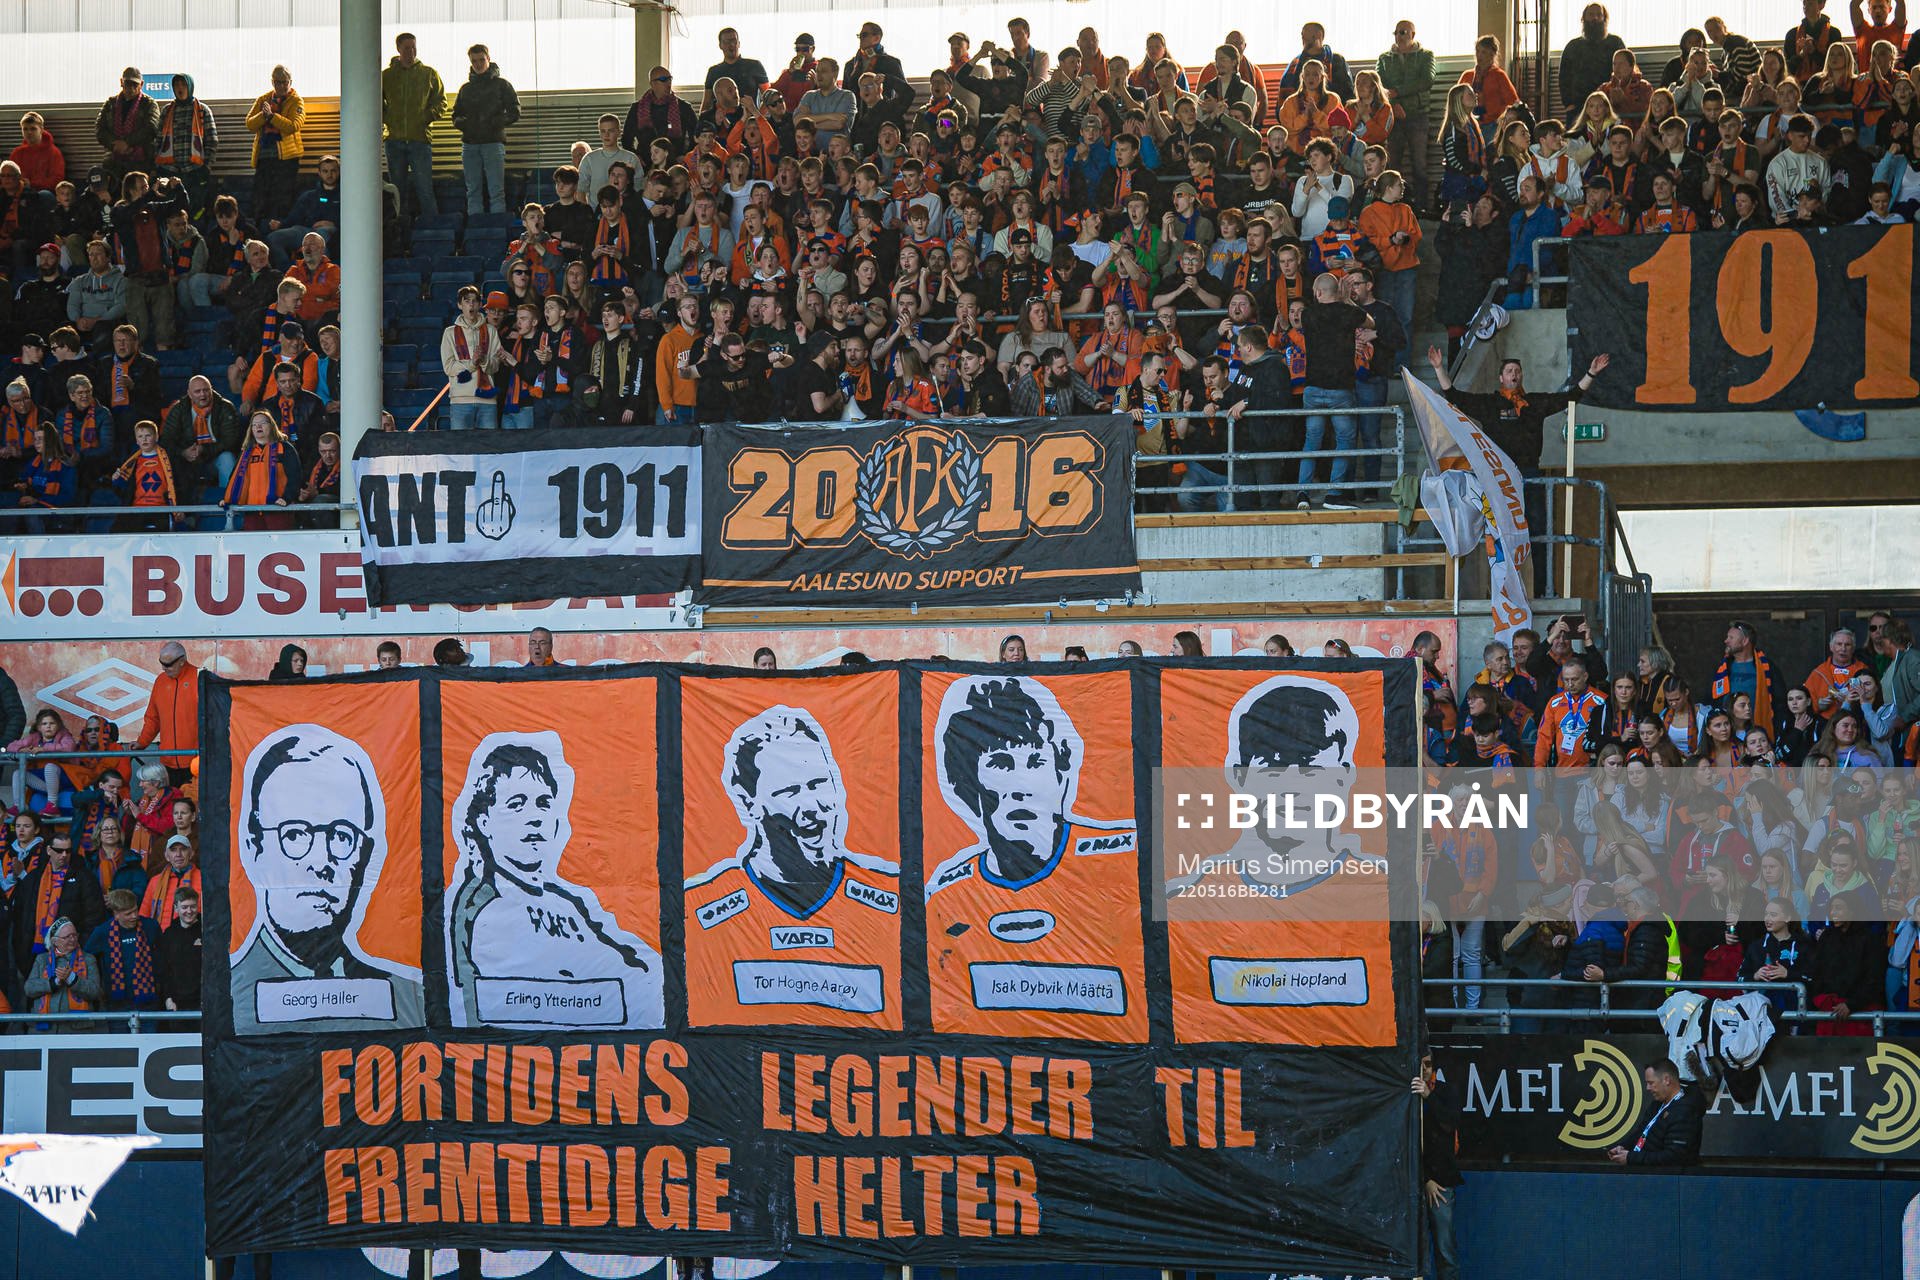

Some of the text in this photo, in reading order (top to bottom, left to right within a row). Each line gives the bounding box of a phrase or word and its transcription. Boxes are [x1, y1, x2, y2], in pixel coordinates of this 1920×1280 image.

[145, 82, 163, 91] FELT
[548, 462, 689, 539] 1911
[790, 565, 1024, 593] AALESUND SUPPORT
[861, 888, 896, 909] MAX
[774, 932, 829, 945] VARD
[754, 975, 858, 998] Tor Hogne Aarøy
[992, 979, 1113, 999] Isak Dybvik Määttä
[1241, 972, 1347, 989] Nikolai Hopland
[282, 991, 360, 1008] Georg Haller
[506, 992, 602, 1009] Erling Ytterland
[321, 1040, 1256, 1148] FORTIDENS LEGENDER TIL
[1436, 1063, 1564, 1118] MFI
[1705, 1065, 1857, 1121] AMFI
[324, 1142, 1041, 1239] FREMTIDIGE HELTER
